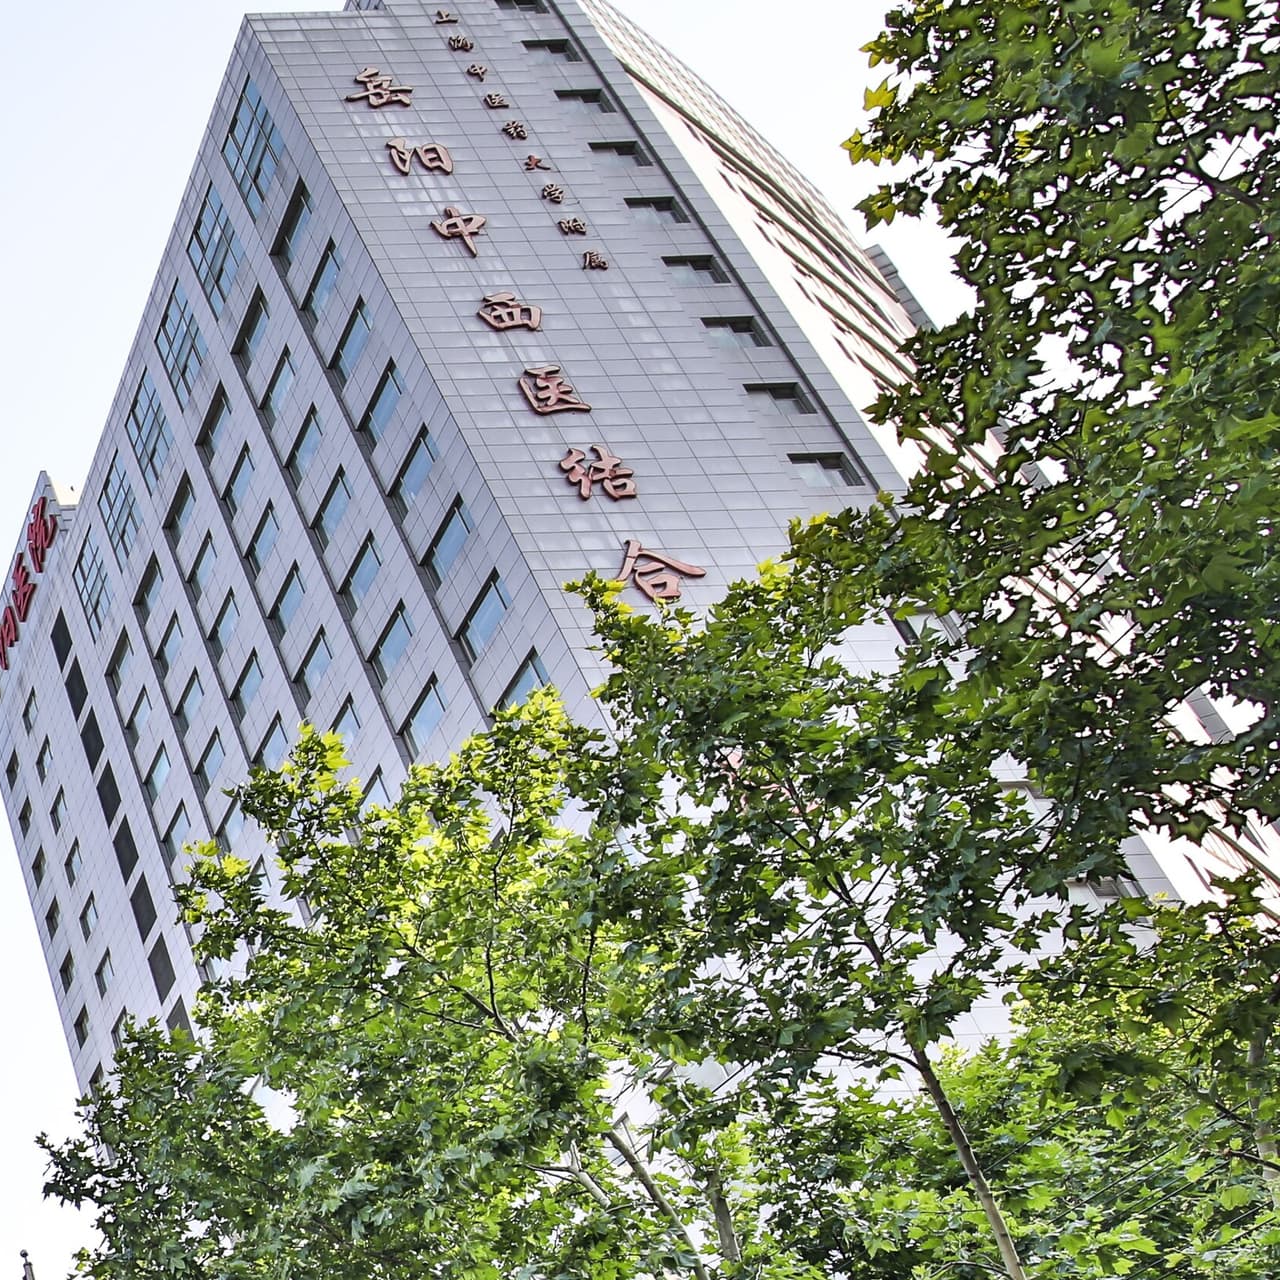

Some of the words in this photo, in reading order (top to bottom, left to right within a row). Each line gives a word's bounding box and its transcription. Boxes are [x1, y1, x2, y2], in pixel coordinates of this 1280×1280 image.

[345, 66, 707, 601] 岳阳中西医结合
